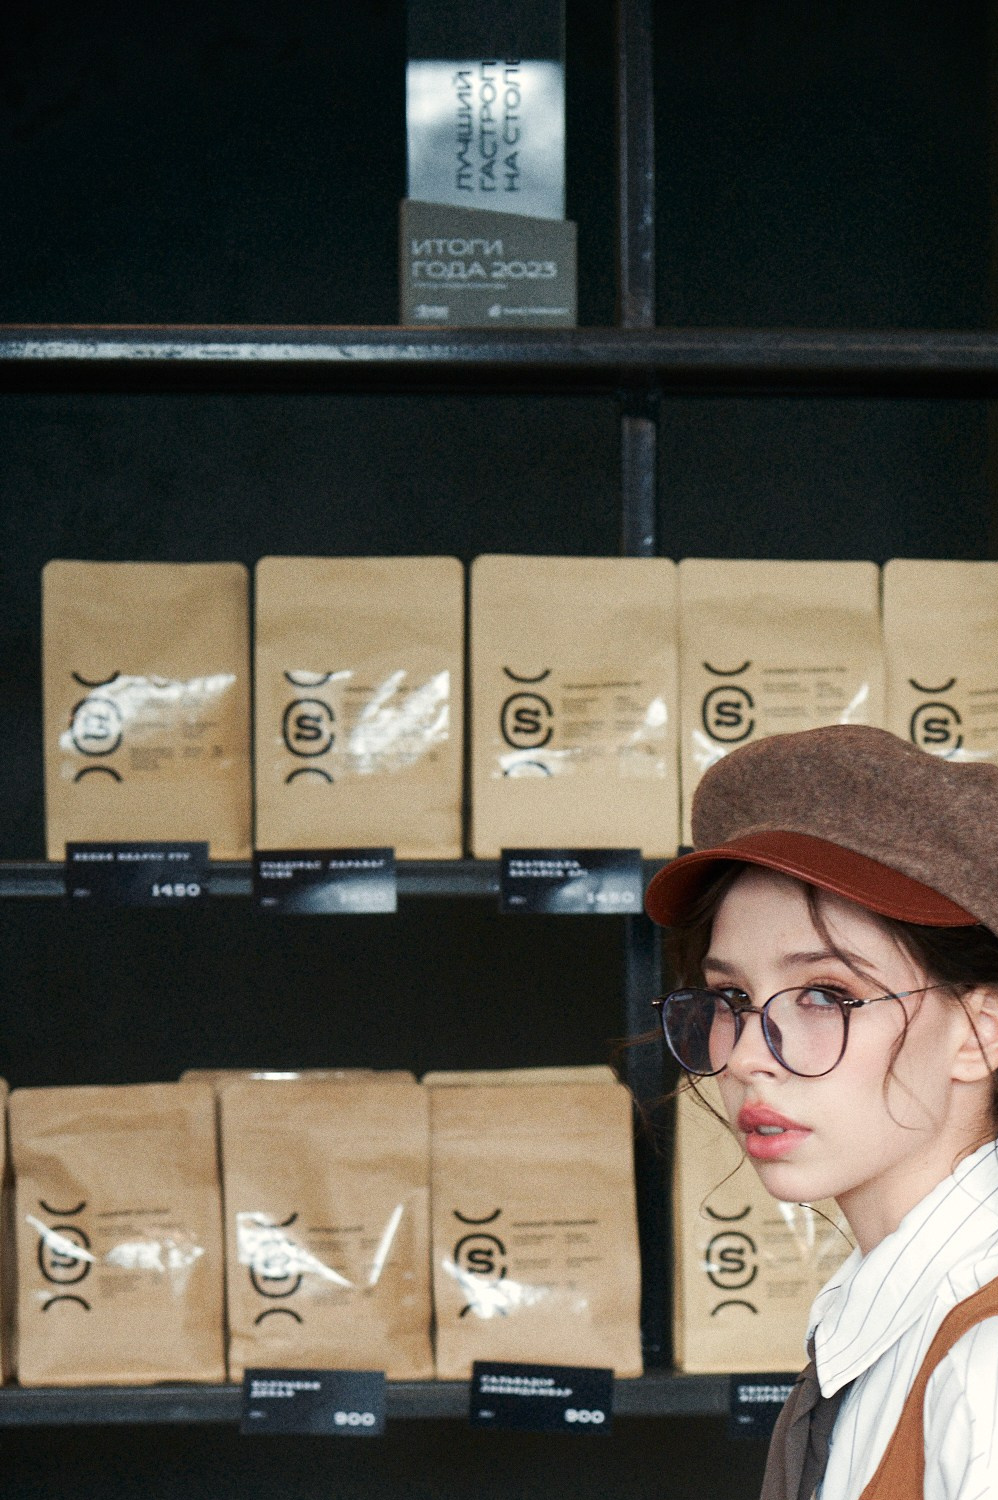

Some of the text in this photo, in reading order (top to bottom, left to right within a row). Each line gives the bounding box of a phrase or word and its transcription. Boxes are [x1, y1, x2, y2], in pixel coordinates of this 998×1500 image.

[411, 238, 503, 255] ИТОГИ
[411, 260, 558, 279] ГОДА 2023
